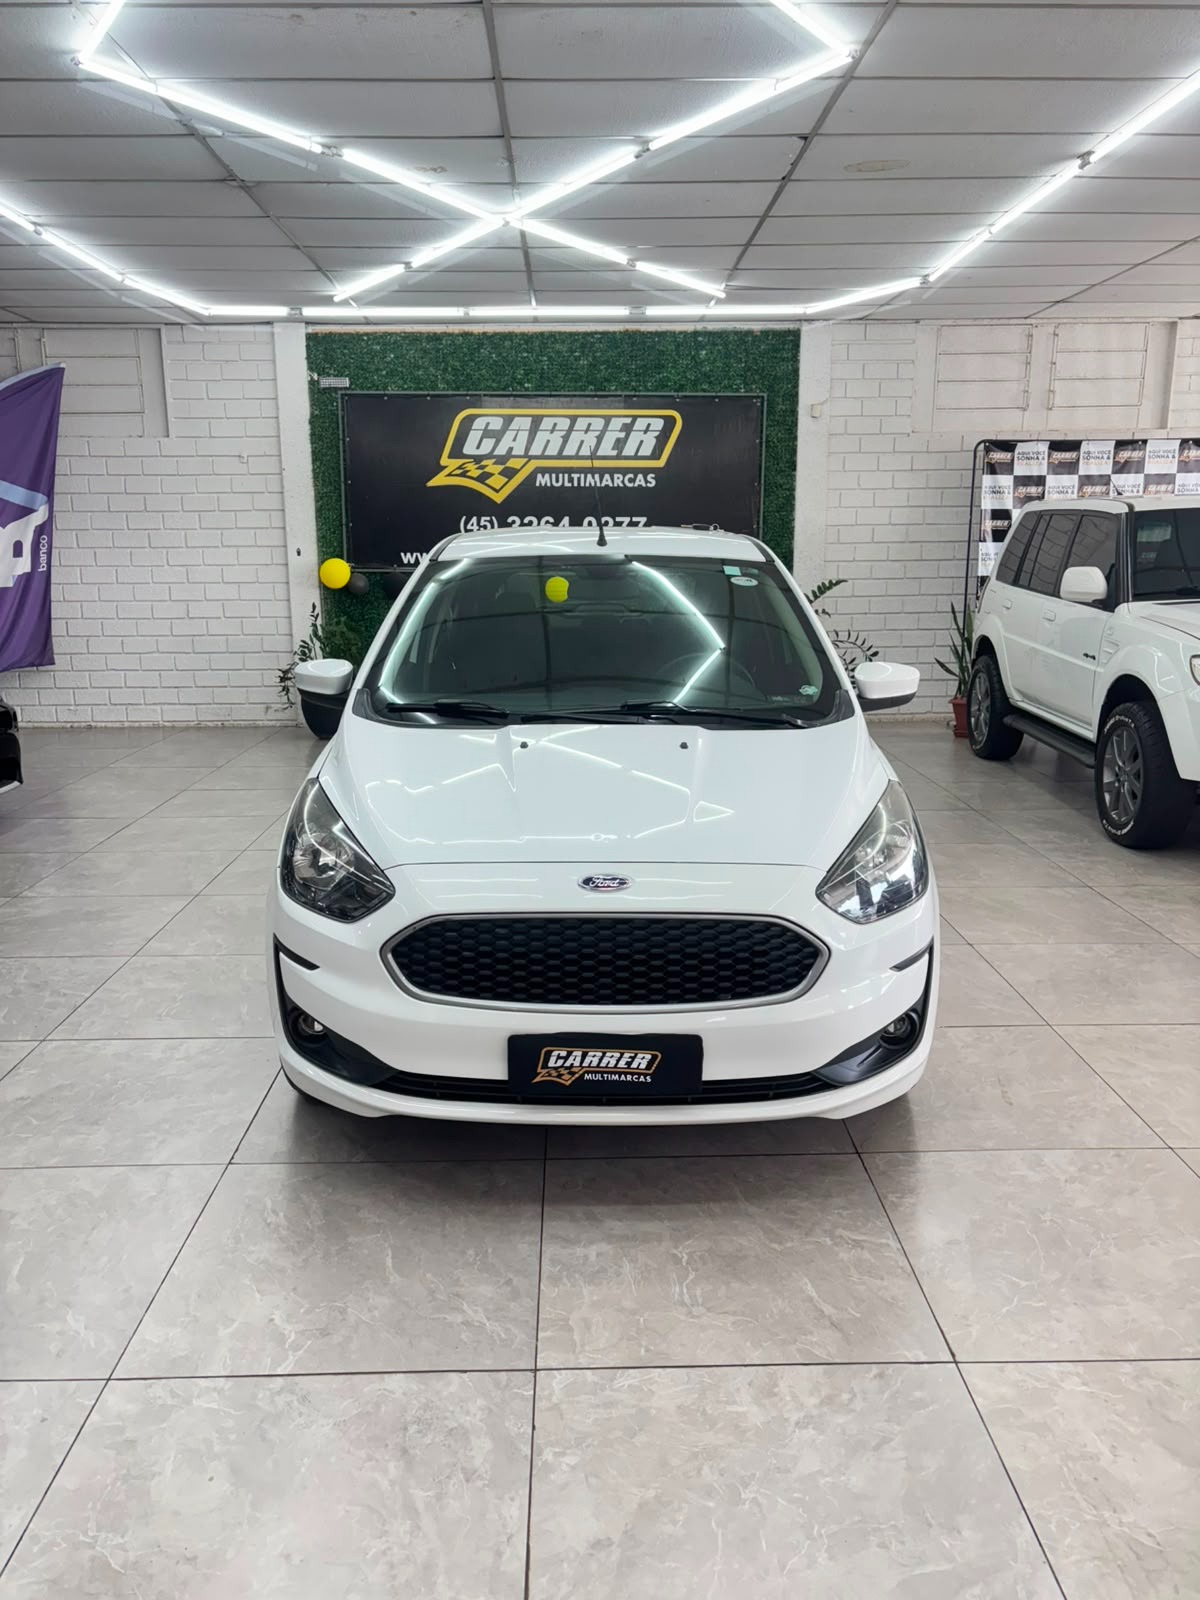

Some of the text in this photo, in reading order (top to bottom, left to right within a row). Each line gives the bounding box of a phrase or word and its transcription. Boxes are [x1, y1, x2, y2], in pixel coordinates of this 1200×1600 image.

[462, 416, 665, 457] CARRER
[535, 473, 656, 488] MULTIMARCAS
[460, 515, 499, 533] (45)
[37, 535, 48, 572] banco
[589, 875, 620, 888] Ford
[547, 1050, 652, 1070] CARRER
[584, 1073, 652, 1083] MULTIMARCAS
